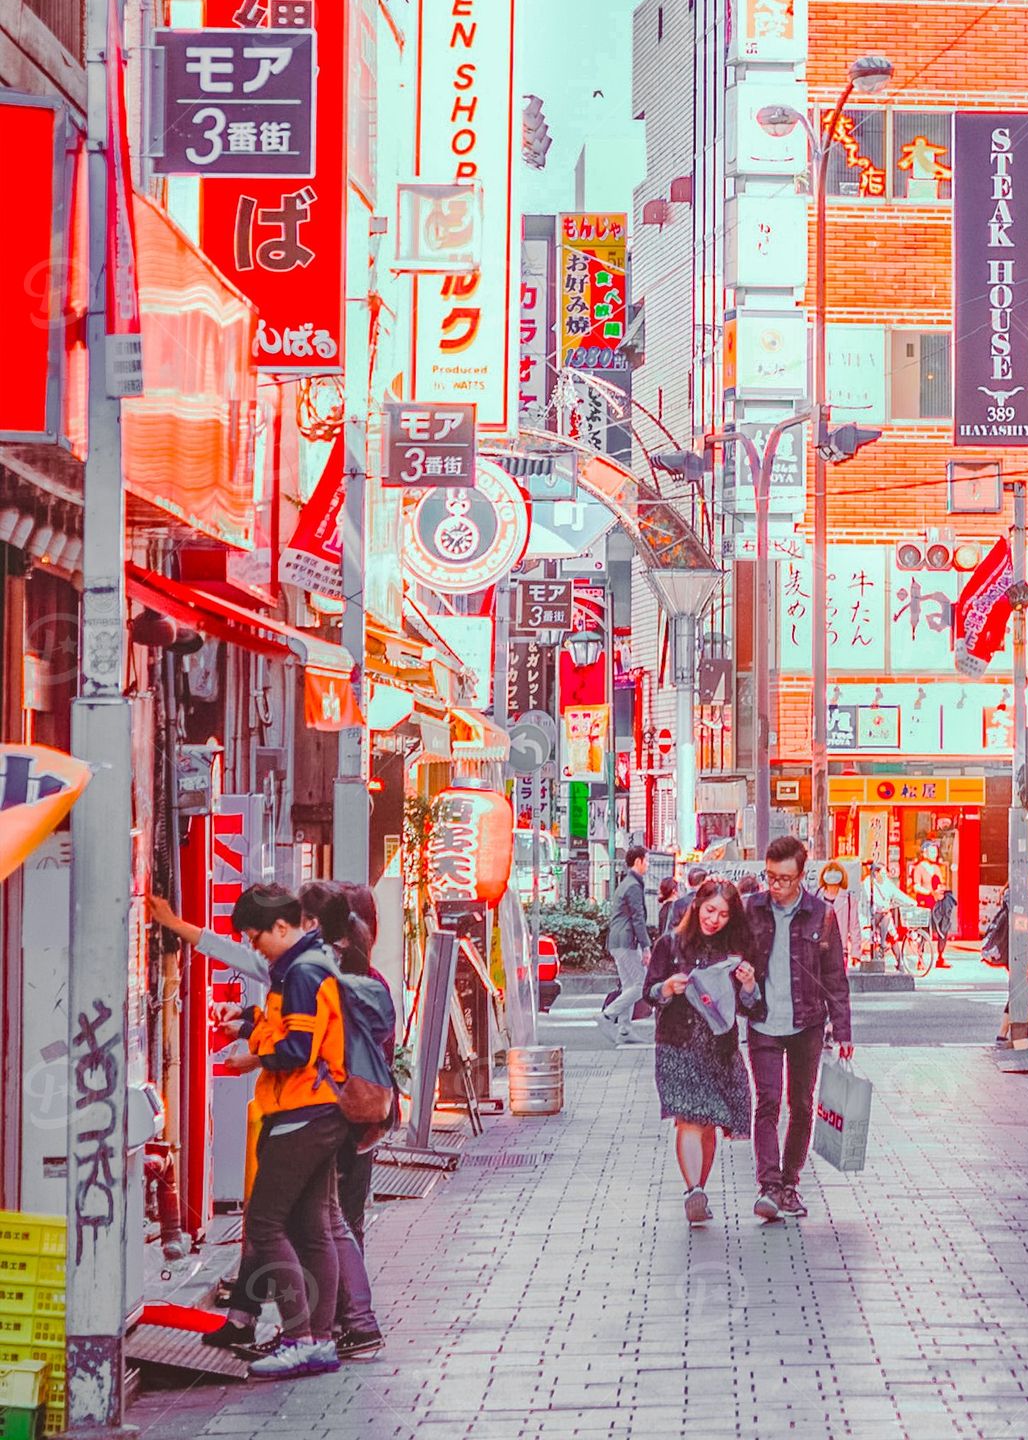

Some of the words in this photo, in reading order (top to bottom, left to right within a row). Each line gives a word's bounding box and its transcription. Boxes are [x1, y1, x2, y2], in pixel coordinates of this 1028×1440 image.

[186, 46, 293, 94] モア
[185, 106, 292, 166] 3番街
[988, 128, 1015, 247] STEAK
[563, 216, 624, 242] もんじゃ
[566, 254, 590, 335] お好み焼
[988, 260, 1015, 379] HOUSE
[252, 320, 338, 359] んばる
[432, 365, 488, 375] Produced
[401, 412, 464, 441] モア
[987, 406, 1015, 422] 389
[400, 448, 463, 483] 3番街
[529, 584, 566, 602] モア
[849, 570, 874, 646] 牛たん
[529, 606, 564, 627] 3番街
[900, 783, 937, 799] 松屋
